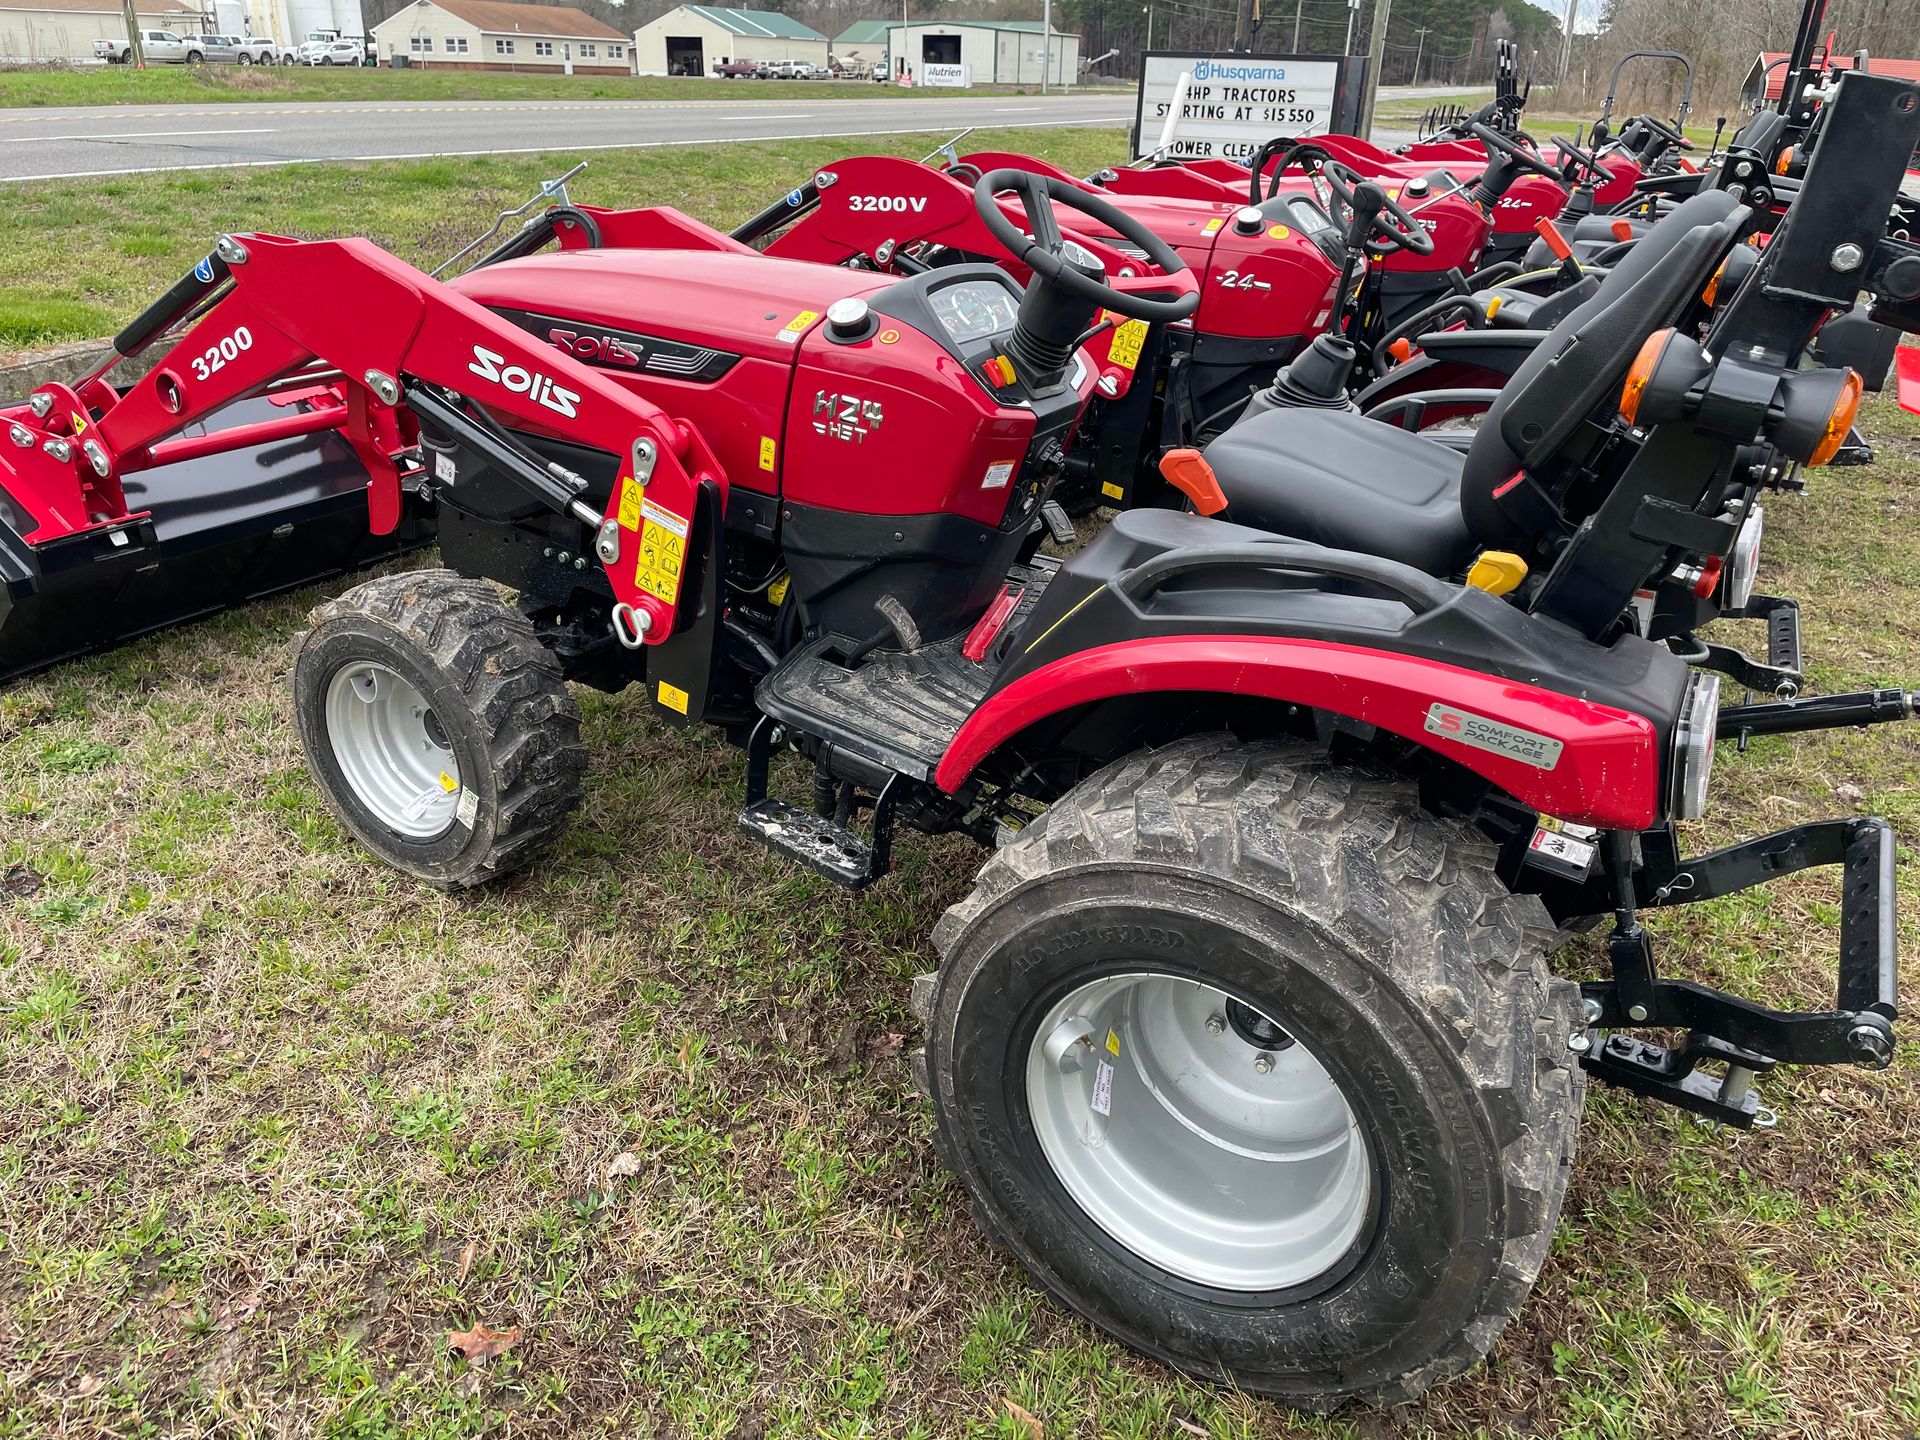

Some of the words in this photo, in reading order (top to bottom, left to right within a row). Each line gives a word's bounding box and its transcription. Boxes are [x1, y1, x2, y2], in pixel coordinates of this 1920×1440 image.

[928, 67, 962, 77] Nutrien
[1210, 64, 1286, 81] Husqvarna
[1186, 85, 1211, 99] 4HP
[1223, 87, 1296, 103] TRACTORS
[1156, 103, 1224, 119] STRTING
[1234, 106, 1253, 120] AT
[191, 326, 253, 381] 3200
[814, 390, 884, 430] H24
[1464, 729, 1544, 760] PACKAGE
[1467, 720, 1547, 750] COMFORT
[1097, 924, 1186, 949] GUARD
